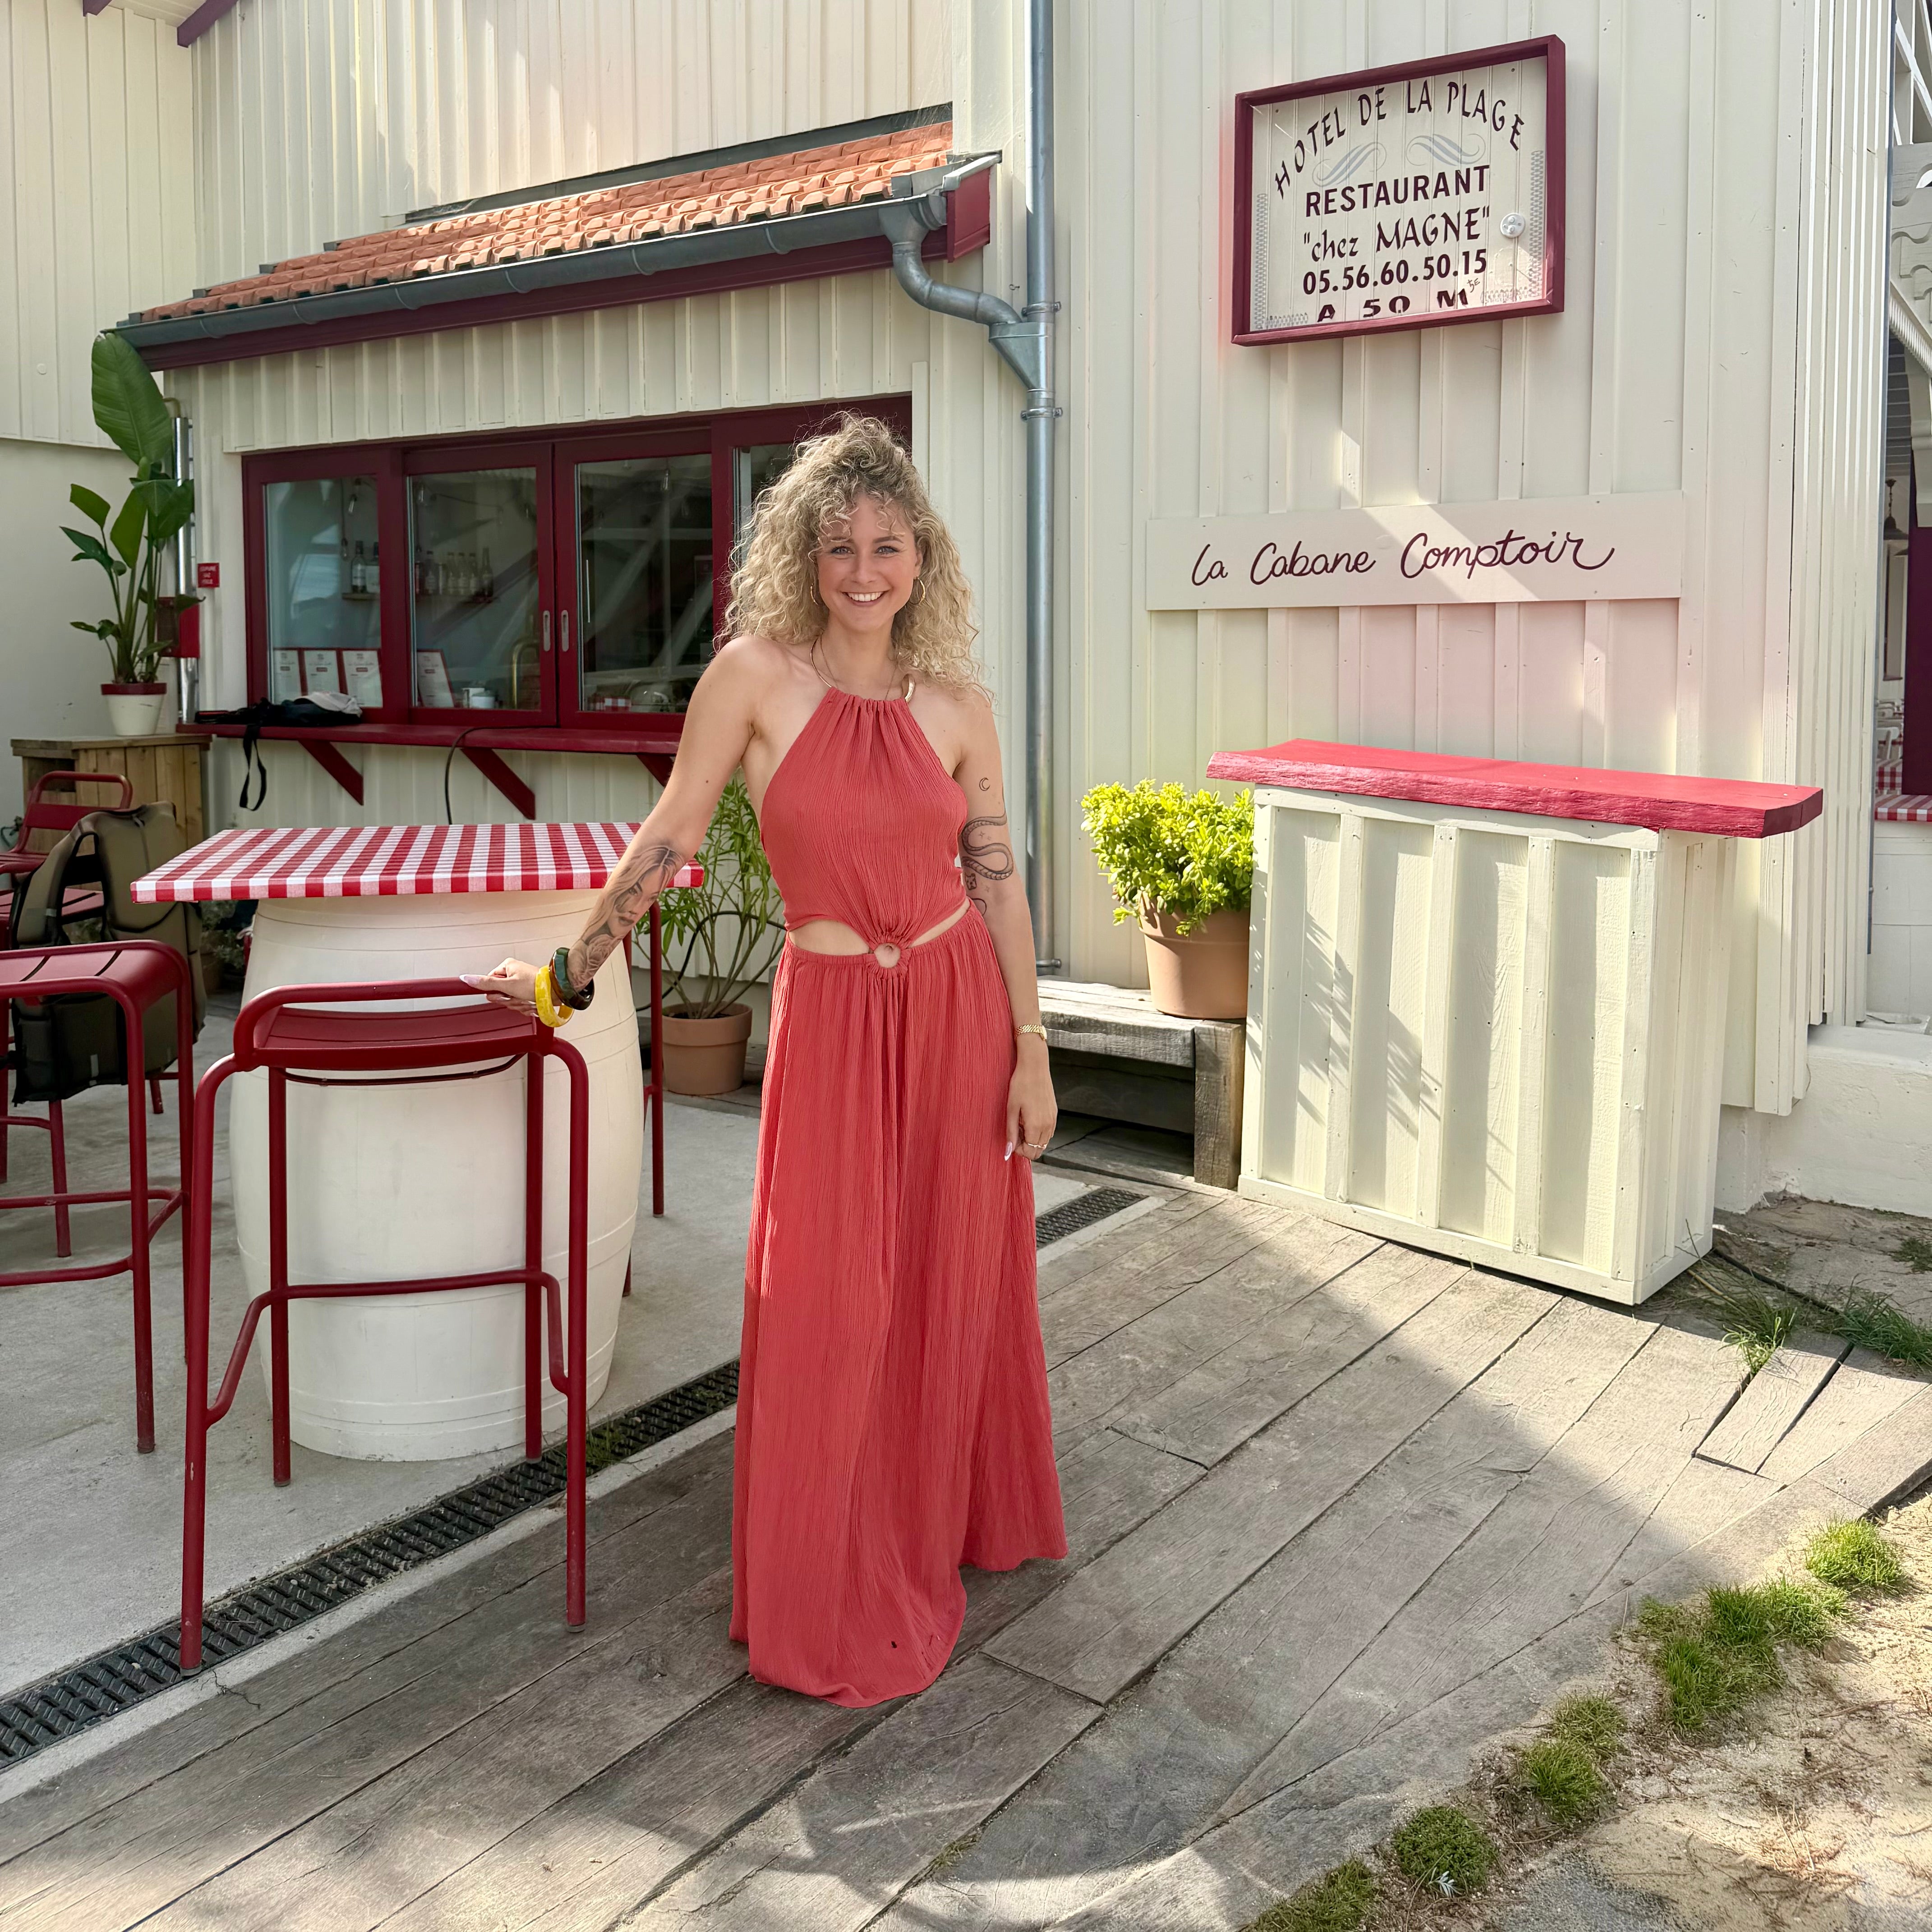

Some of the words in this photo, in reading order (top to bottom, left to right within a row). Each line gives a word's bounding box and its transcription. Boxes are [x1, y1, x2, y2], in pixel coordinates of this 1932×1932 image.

[1275, 107, 1346, 199] HOTEL
[1357, 87, 1387, 126] DE
[1406, 79, 1432, 114] LA
[1447, 81, 1524, 151] PLAGE
[1305, 164, 1490, 217] RESTAURANT
[1303, 229, 1359, 262] "chez
[1376, 205, 1490, 253] MAGNE"
[1303, 249, 1487, 295] 05.56.60.50.15
[1317, 304, 1336, 323] A
[1363, 295, 1411, 318] 50
[1191, 543, 1228, 586] La
[1250, 541, 1376, 585] Cabane
[1400, 529, 1615, 579] Comptoir
